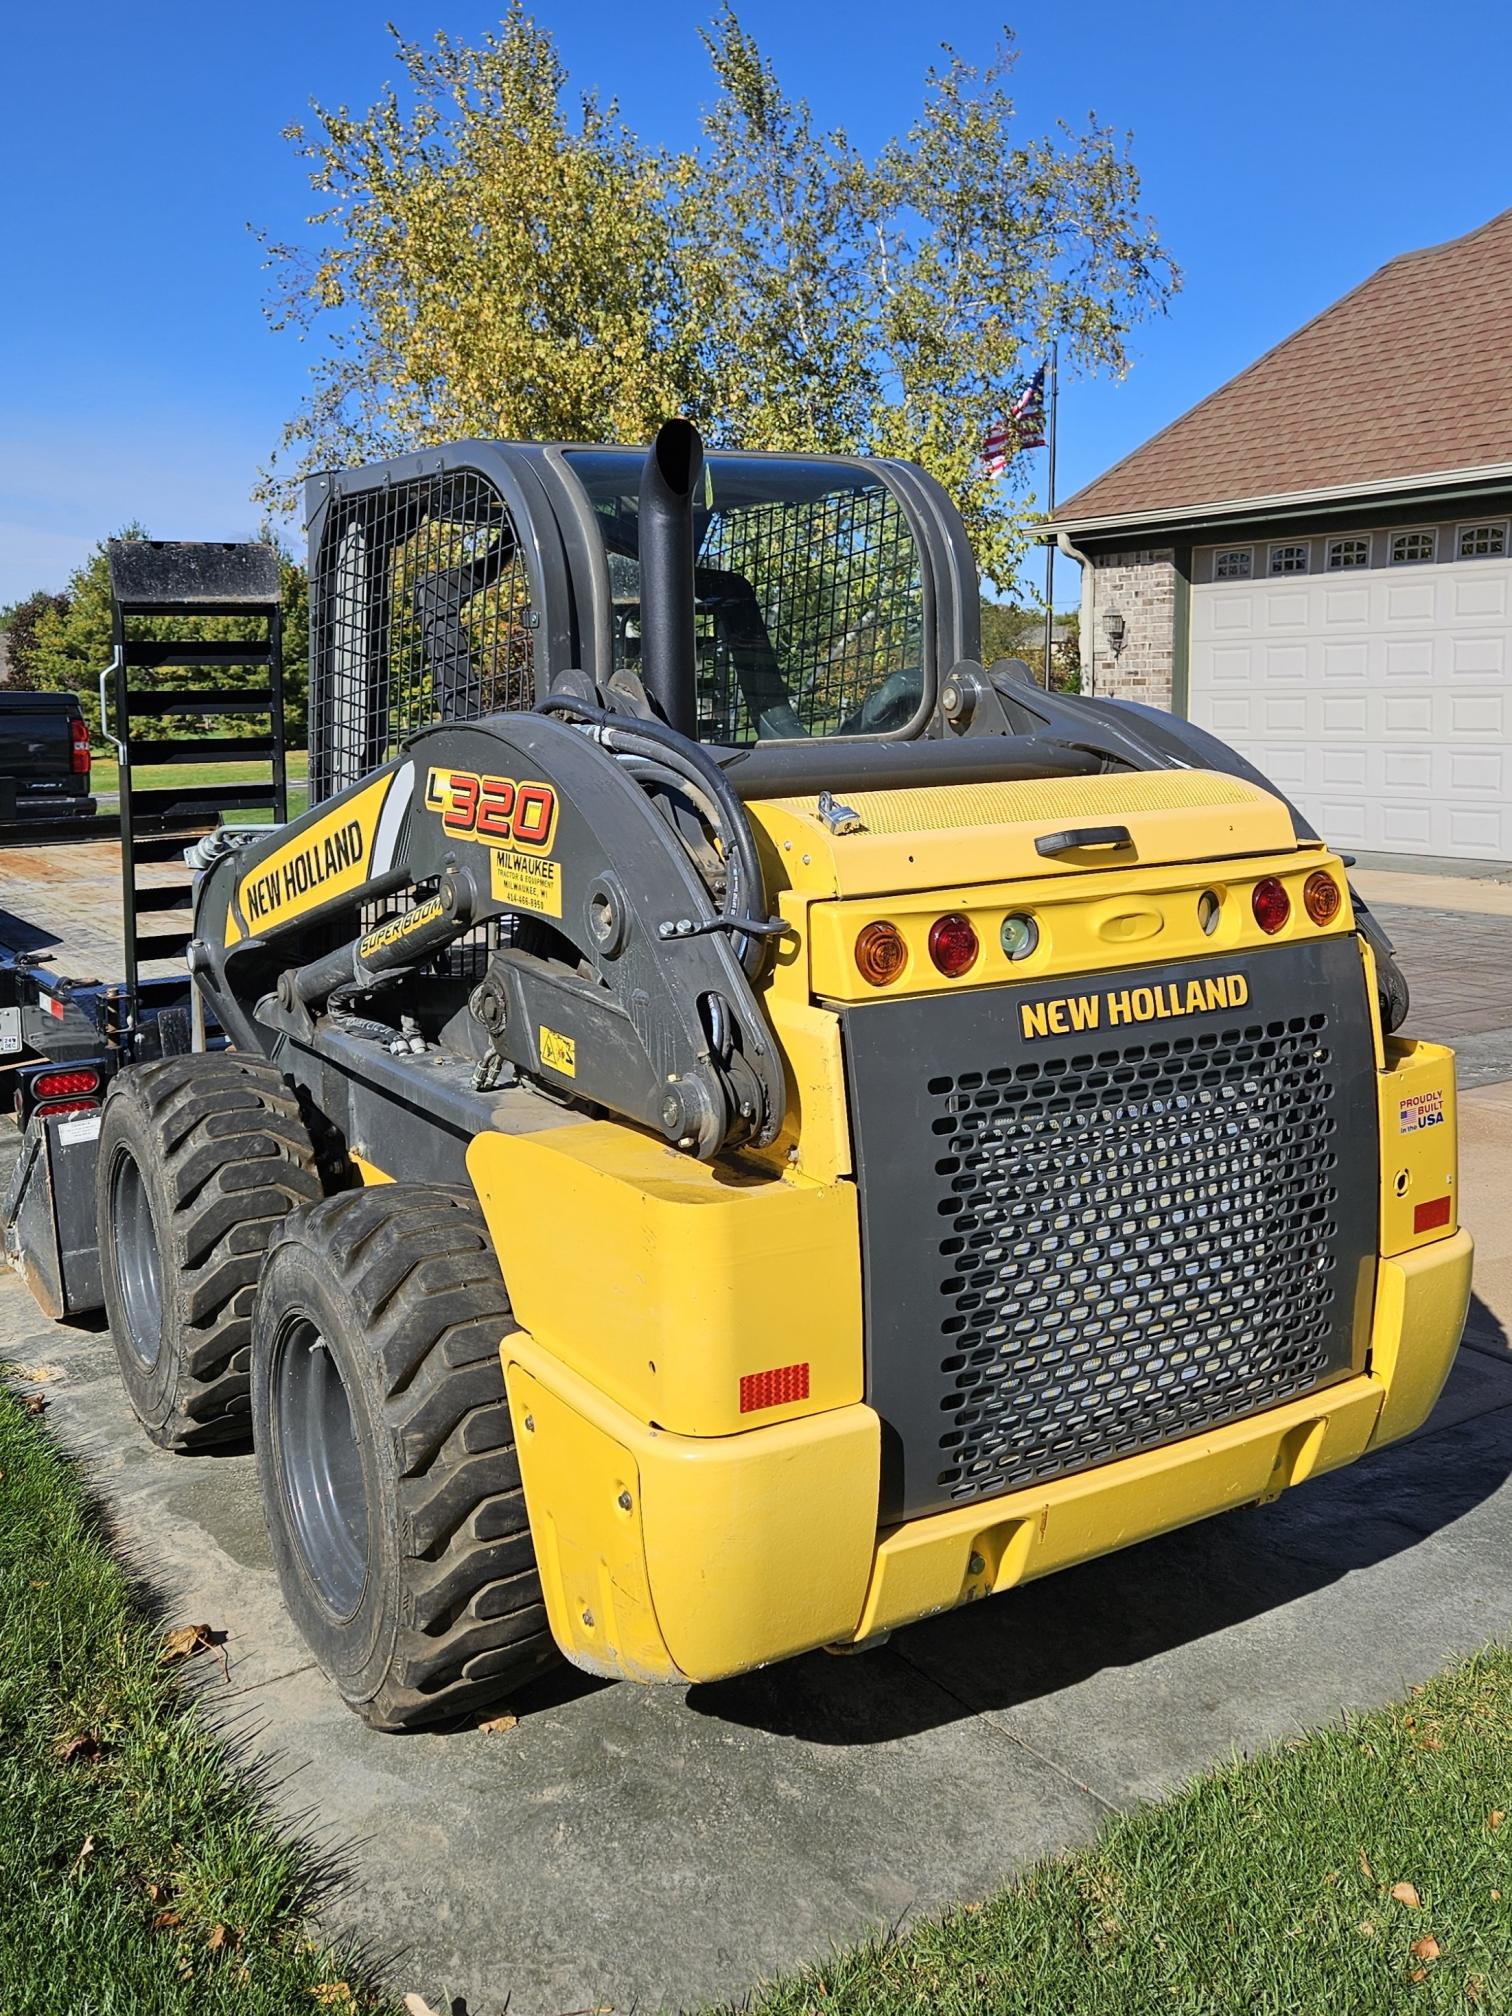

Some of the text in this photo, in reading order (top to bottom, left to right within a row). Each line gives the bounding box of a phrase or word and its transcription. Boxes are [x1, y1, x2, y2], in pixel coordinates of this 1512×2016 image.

[427, 771, 556, 847] L320
[246, 820, 363, 922] NEW HOLLAND
[496, 851, 554, 880] MILWAUKEE
[497, 868, 554, 888] TRACTOR & EQUIPMENT
[503, 879, 539, 898] MILWAUKEE,
[361, 897, 443, 957] SUPER BOOM
[1021, 974, 1249, 1039] NEW HOLLAND
[1400, 1089, 1443, 1109] PROUDLY
[1417, 1100, 1444, 1115] BUILT
[1418, 1111, 1444, 1128] USA
